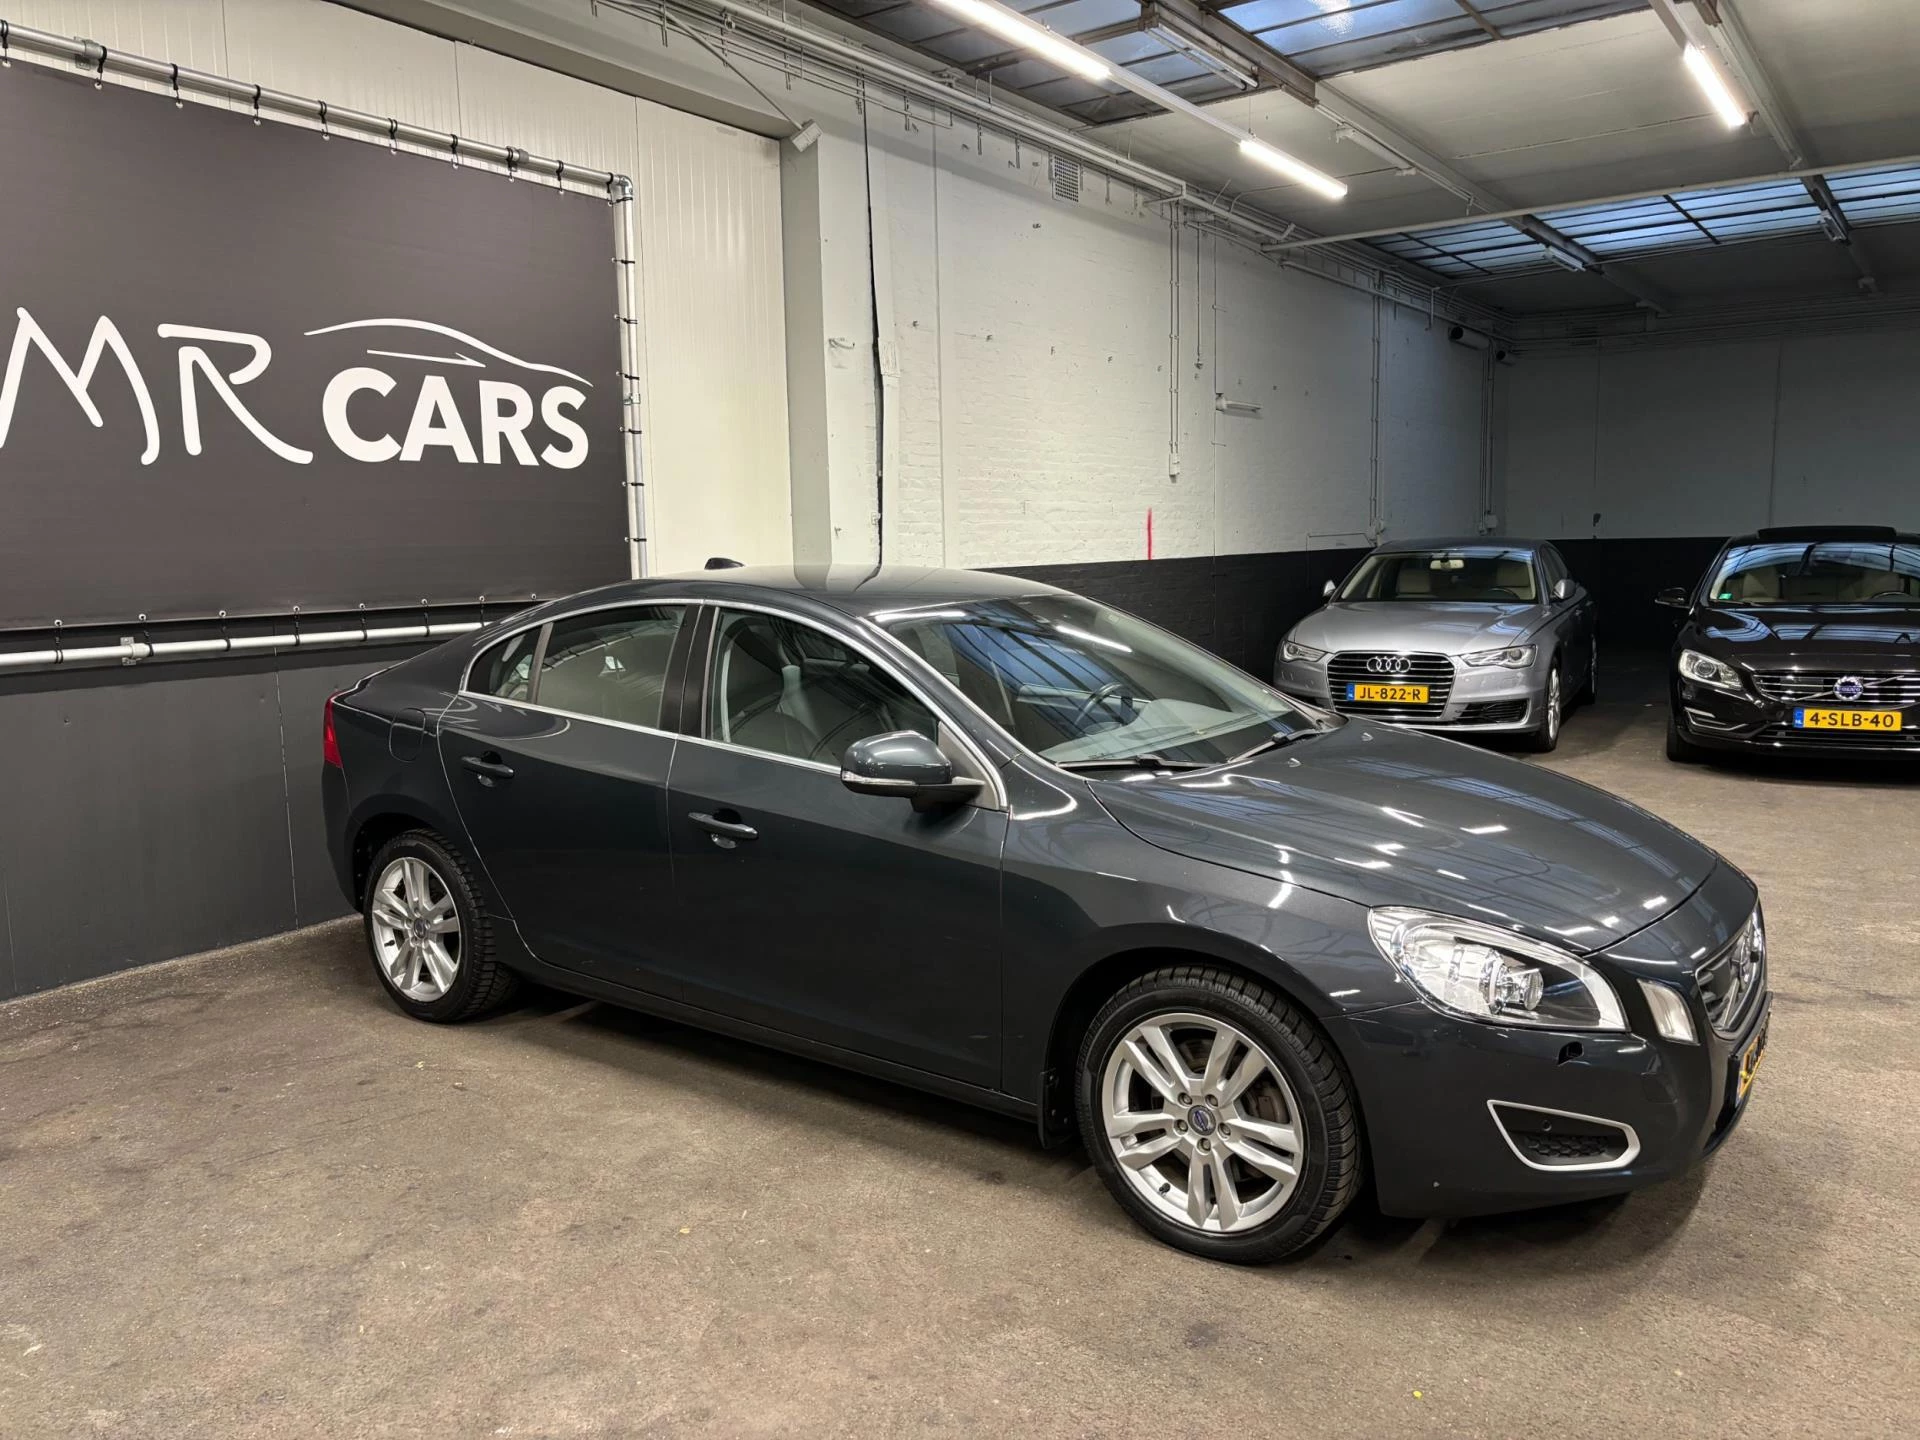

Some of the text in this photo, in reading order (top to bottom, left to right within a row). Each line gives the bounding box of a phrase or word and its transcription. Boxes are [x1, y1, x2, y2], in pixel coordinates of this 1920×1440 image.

[0, 307, 589, 470] MR CARS
[1360, 687, 1421, 701] JL-822-R
[1809, 712, 1895, 728] 4-SLB-40
